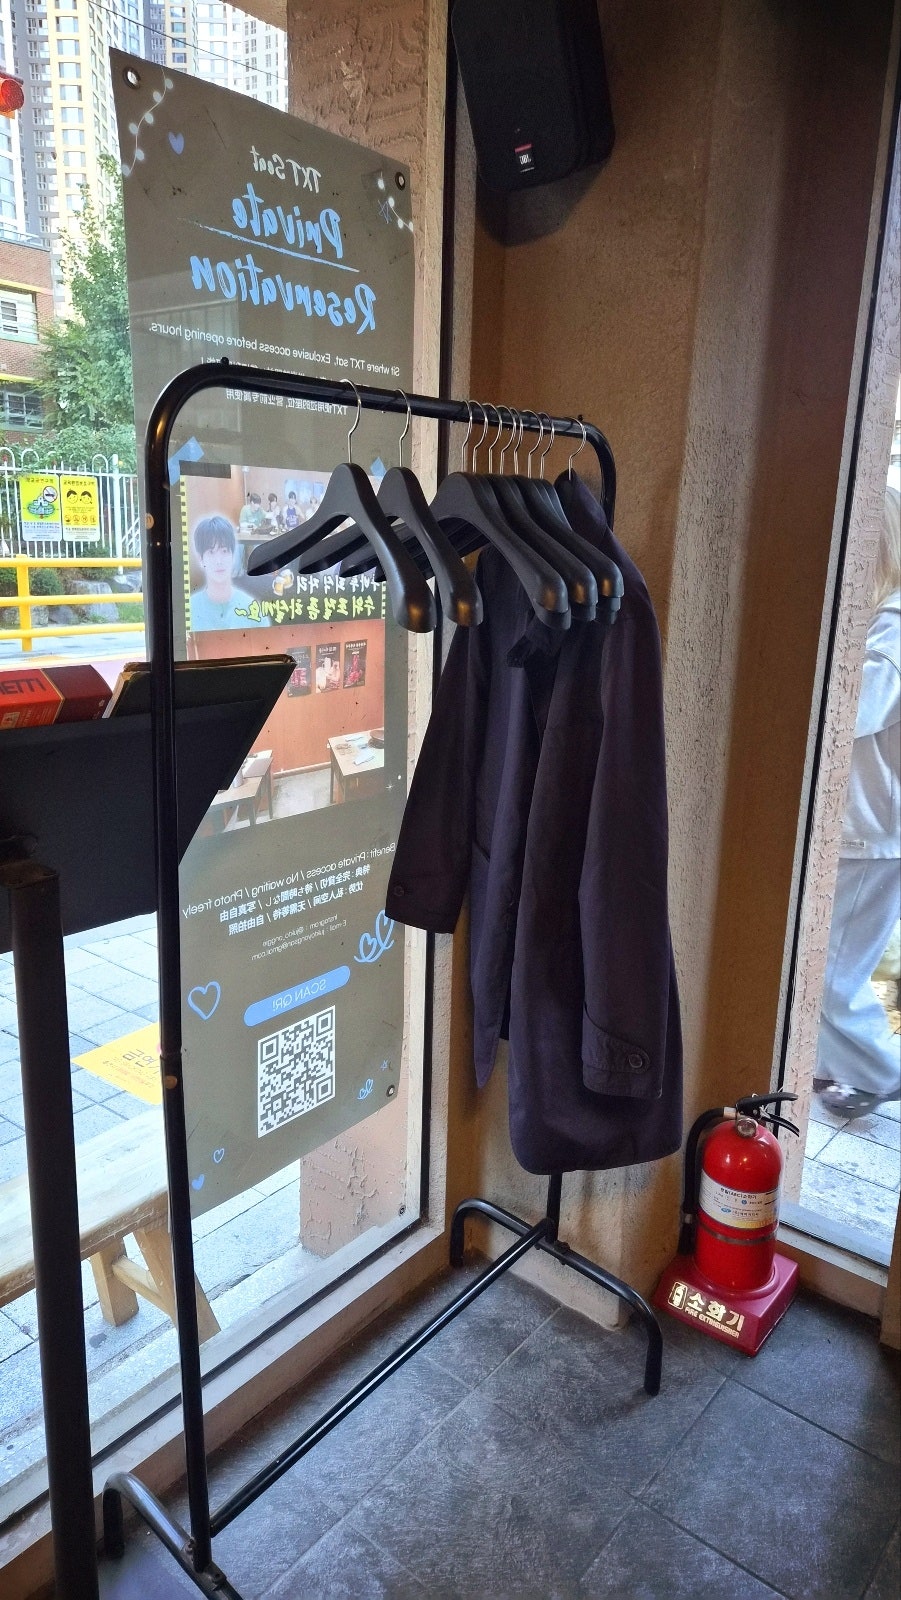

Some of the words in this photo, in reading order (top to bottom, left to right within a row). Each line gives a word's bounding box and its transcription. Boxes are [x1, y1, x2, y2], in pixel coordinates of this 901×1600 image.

[685, 1307, 698, 1318] FIRE
[699, 1314, 740, 1338] EXTINGUISHER
[687, 1293, 745, 1332] 소화기
